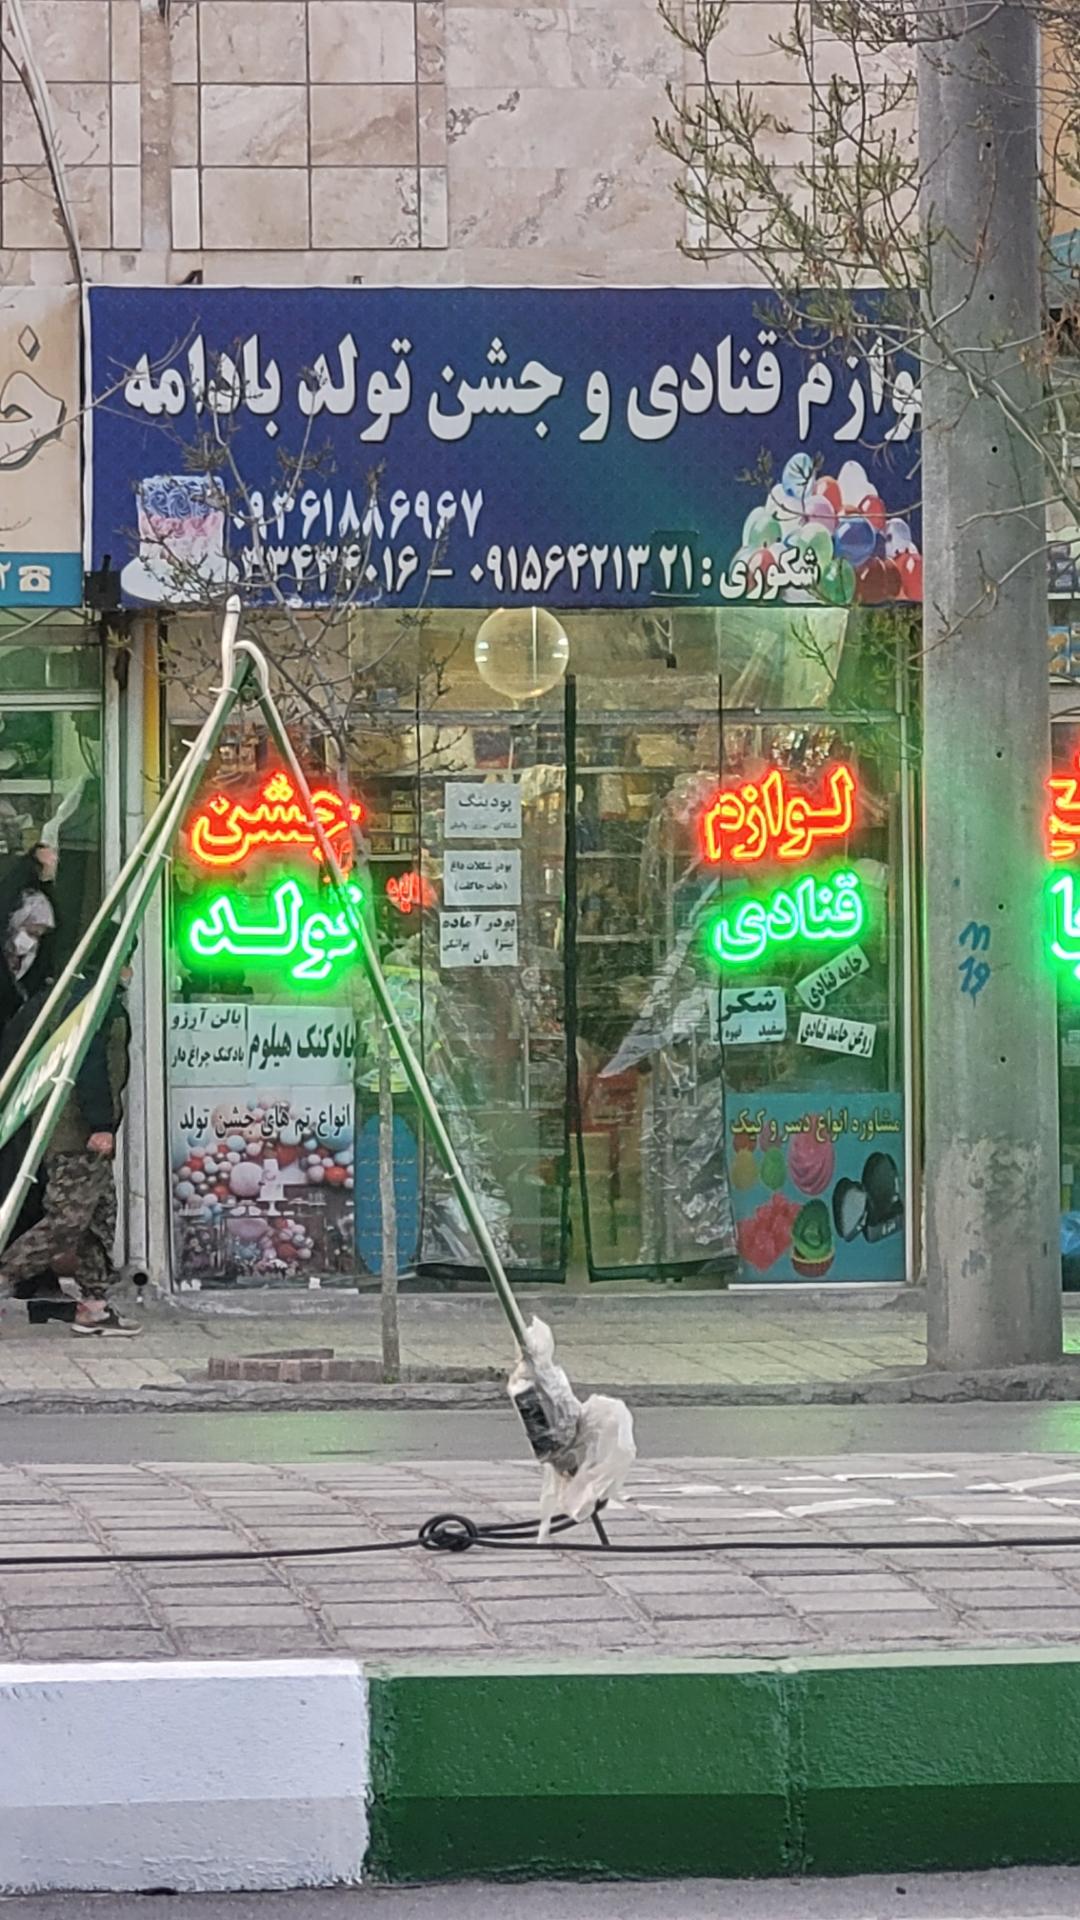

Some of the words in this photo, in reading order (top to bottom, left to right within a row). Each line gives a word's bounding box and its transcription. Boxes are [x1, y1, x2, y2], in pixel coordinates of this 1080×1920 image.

[298, 333, 412, 442] تولد
[427, 337, 564, 441] جشن
[627, 329, 782, 441] قنادی
[798, 336, 922, 441] وازم
[579, 371, 611, 441] و
[191, 773, 362, 864] جشن
[704, 766, 856, 860] لوازم
[190, 880, 363, 979] تولد
[442, 914, 482, 929] آماده
[713, 872, 863, 962] قنادی
[808, 966, 838, 1008] قنادی
[169, 1006, 209, 1031] آرزو
[209, 1007, 242, 1030] بالن
[716, 989, 777, 1022] شکر
[297, 1021, 354, 1068] بادکنک
[757, 1019, 783, 1040] سفید
[800, 1016, 829, 1044] قنادی
[169, 1045, 187, 1069] دار
[213, 1045, 245, 1067] بادکنک
[179, 1106, 210, 1138] تولد
[214, 1106, 255, 1139] جشن
[261, 1101, 290, 1136] های
[294, 1106, 311, 1136] تم
[317, 1104, 351, 1137] انواع
[730, 1108, 767, 1140] کیک
[768, 1118, 779, 1142] و
[782, 1115, 811, 1142] دسر
[815, 1107, 849, 1142] انواع
[852, 1108, 900, 1141] مشاوره
